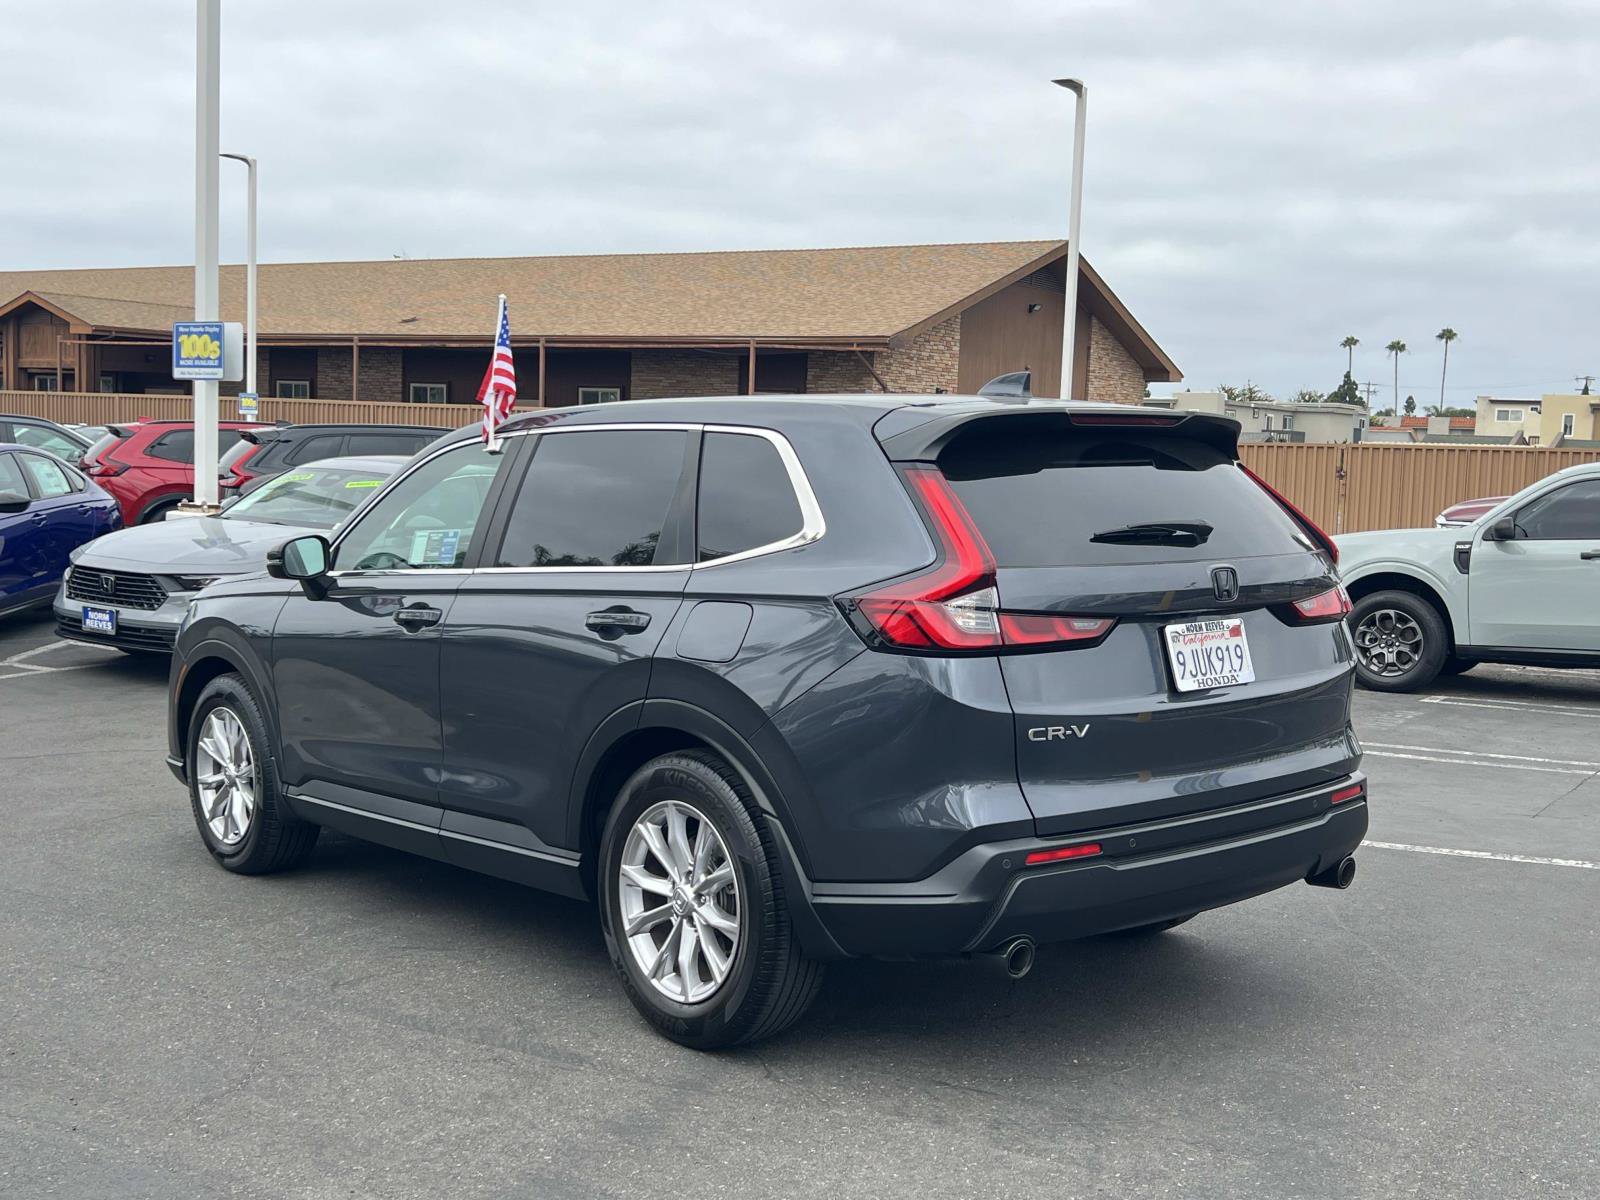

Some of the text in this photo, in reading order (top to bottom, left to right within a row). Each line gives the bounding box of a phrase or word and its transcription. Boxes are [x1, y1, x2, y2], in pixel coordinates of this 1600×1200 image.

[88, 611, 110, 621] NORM
[85, 619, 112, 630] REEVES
[1185, 621, 1225, 633] NORM REEVES
[1183, 632, 1226, 646] California
[1176, 644, 1244, 680] 9JUK919
[1197, 674, 1239, 688] HONDA
[1028, 724, 1090, 741] CR-V
